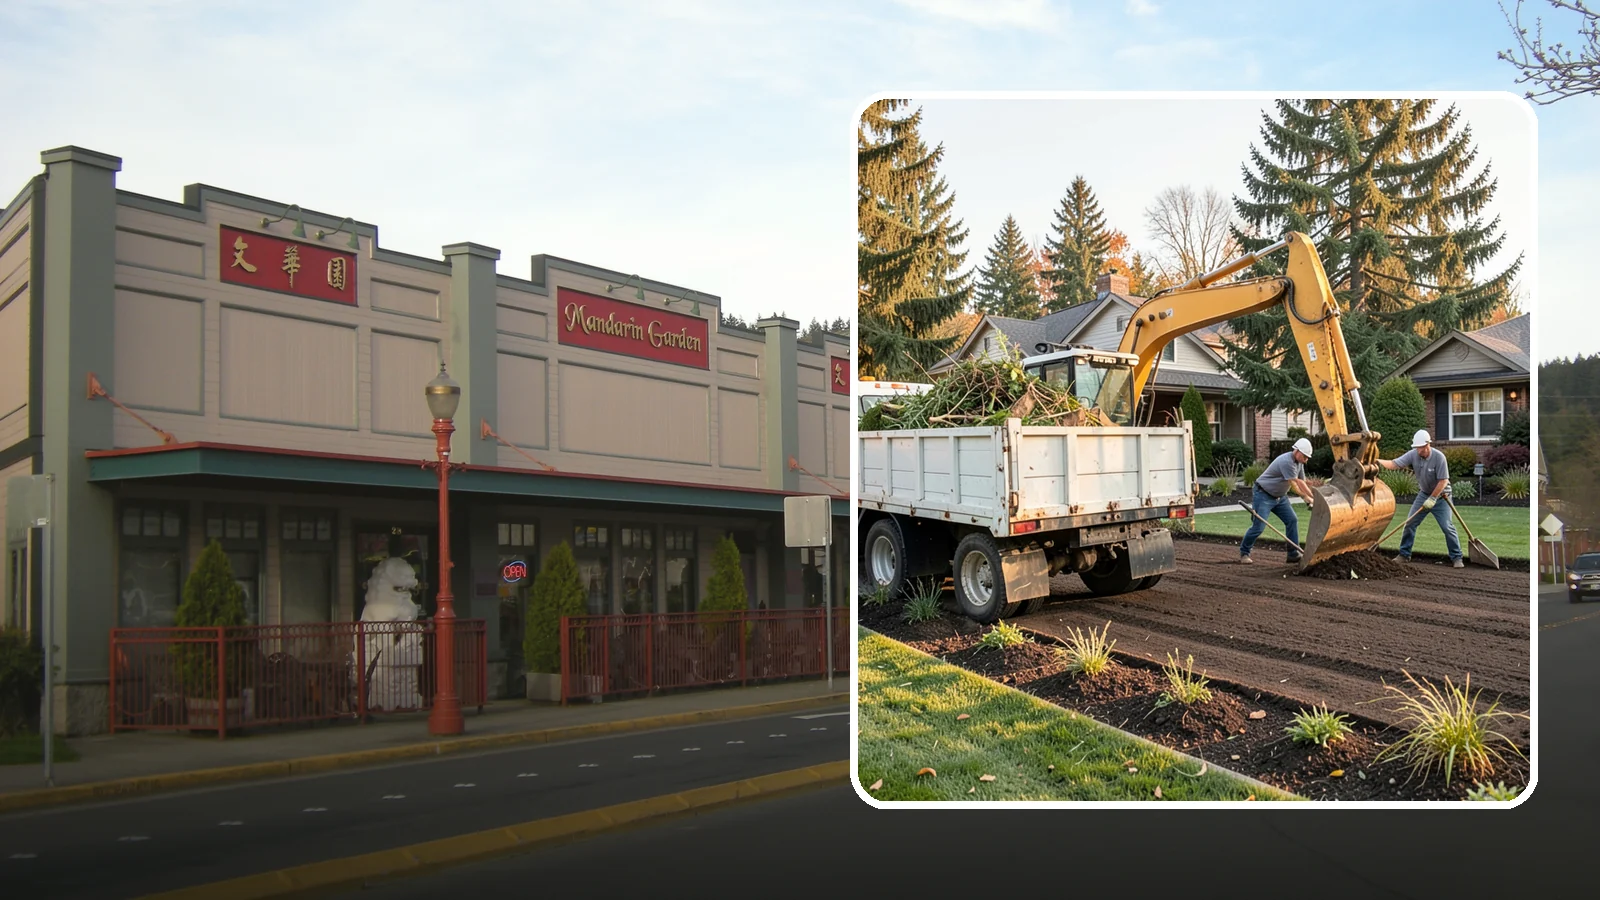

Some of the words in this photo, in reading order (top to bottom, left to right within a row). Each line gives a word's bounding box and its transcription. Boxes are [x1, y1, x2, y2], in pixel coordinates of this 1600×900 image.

[230, 235, 346, 291] 文華園
[564, 302, 644, 341] Mandarin
[648, 320, 702, 352] Garden
[834, 363, 846, 386] 文
[503, 565, 527, 578] OPEN
